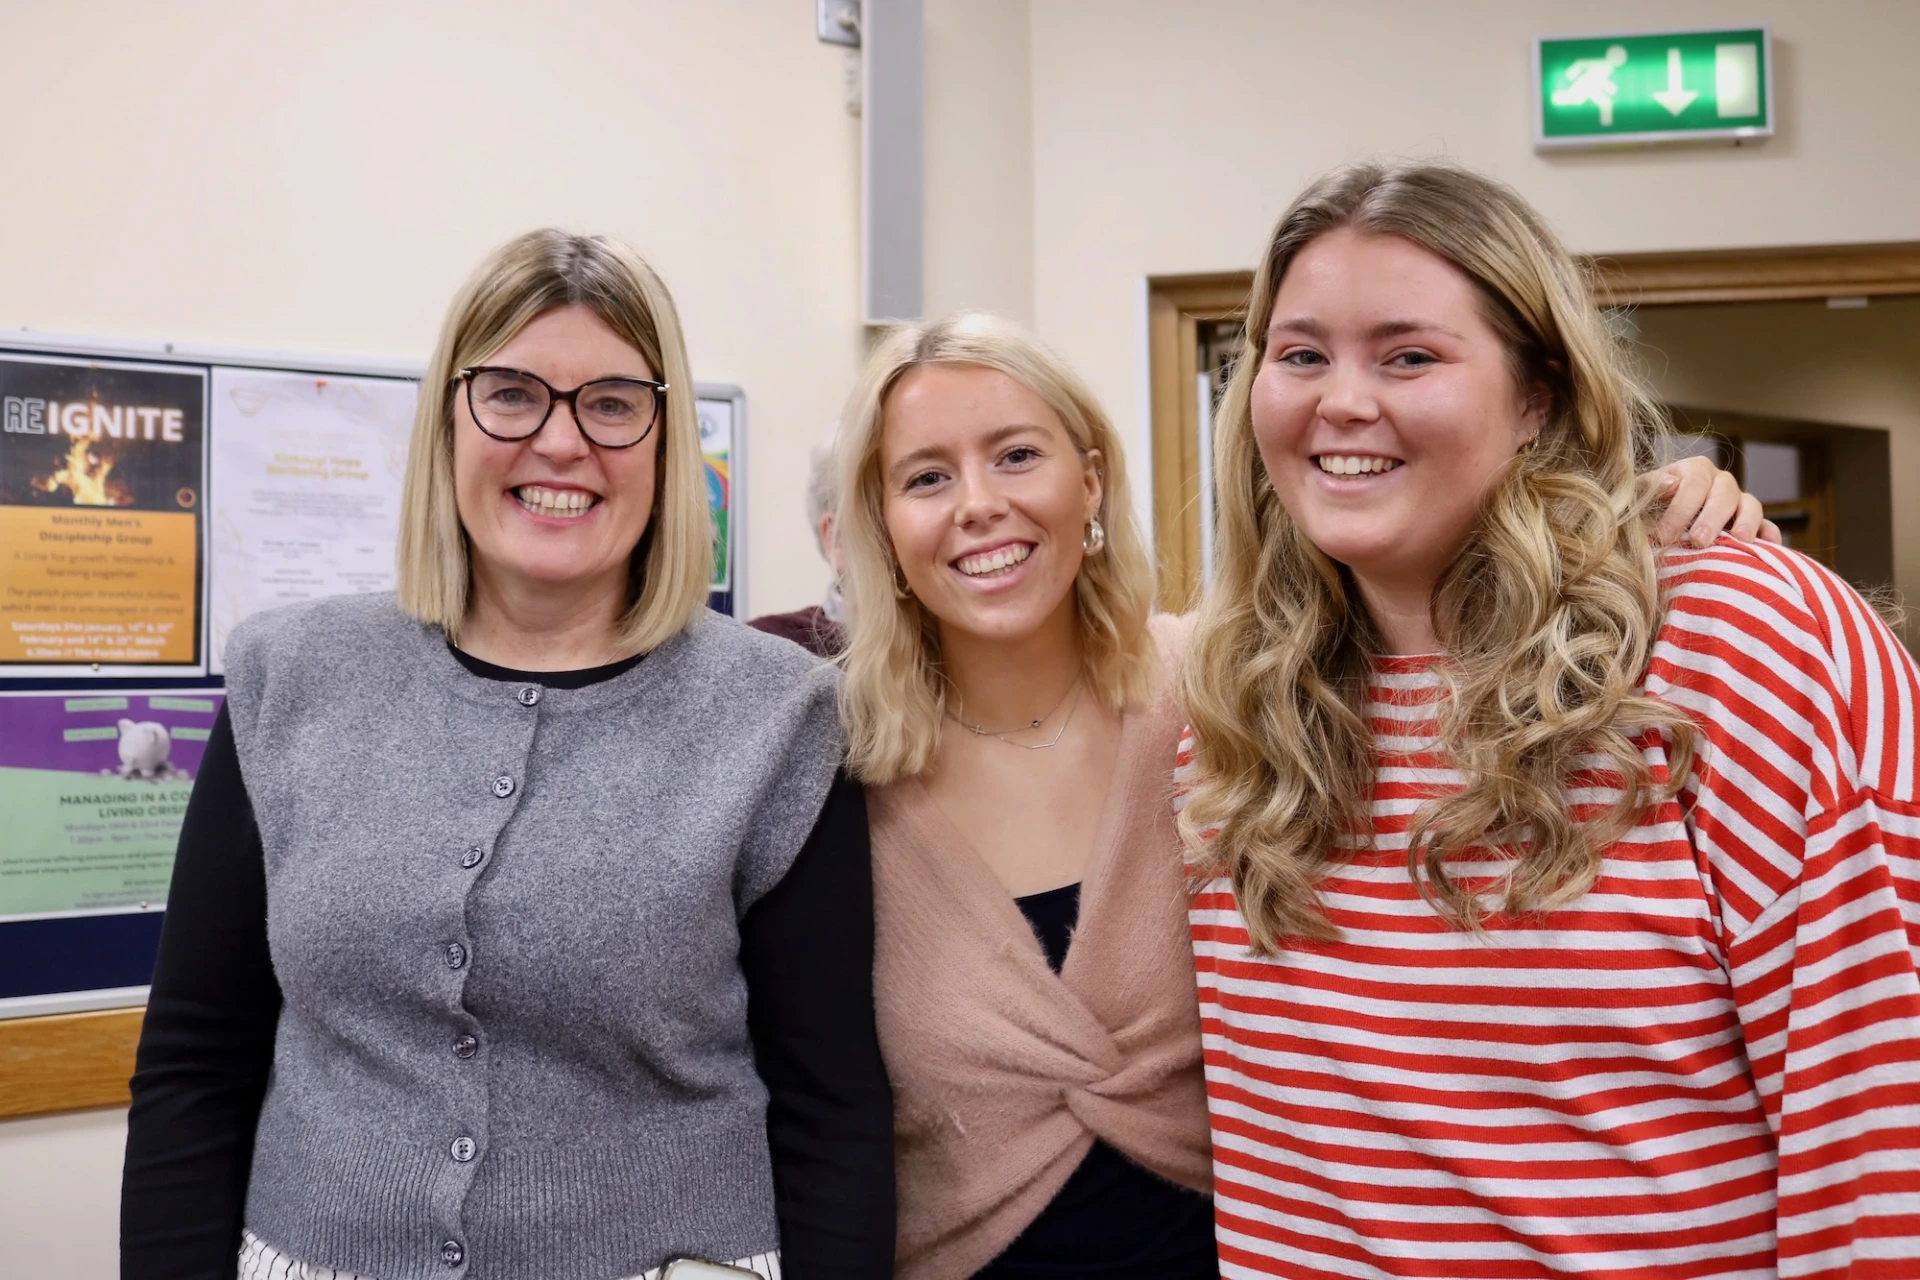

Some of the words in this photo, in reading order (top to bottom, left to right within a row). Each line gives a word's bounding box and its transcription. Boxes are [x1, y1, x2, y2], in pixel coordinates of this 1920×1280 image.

[4, 396, 184, 442] REIGNITE
[51, 515, 102, 528] Monthly
[106, 517, 142, 528] Men's
[39, 530, 112, 544] Discipleship
[116, 533, 153, 546] Group
[11, 621, 62, 632] Saturdays
[19, 634, 64, 646] February
[66, 635, 85, 645] and
[135, 636, 167, 646] March
[59, 792, 138, 806] MANAGING
[141, 792, 155, 803] IN
[157, 792, 167, 803] A
[170, 791, 190, 802] CO
[99, 806, 144, 818] LIVING
